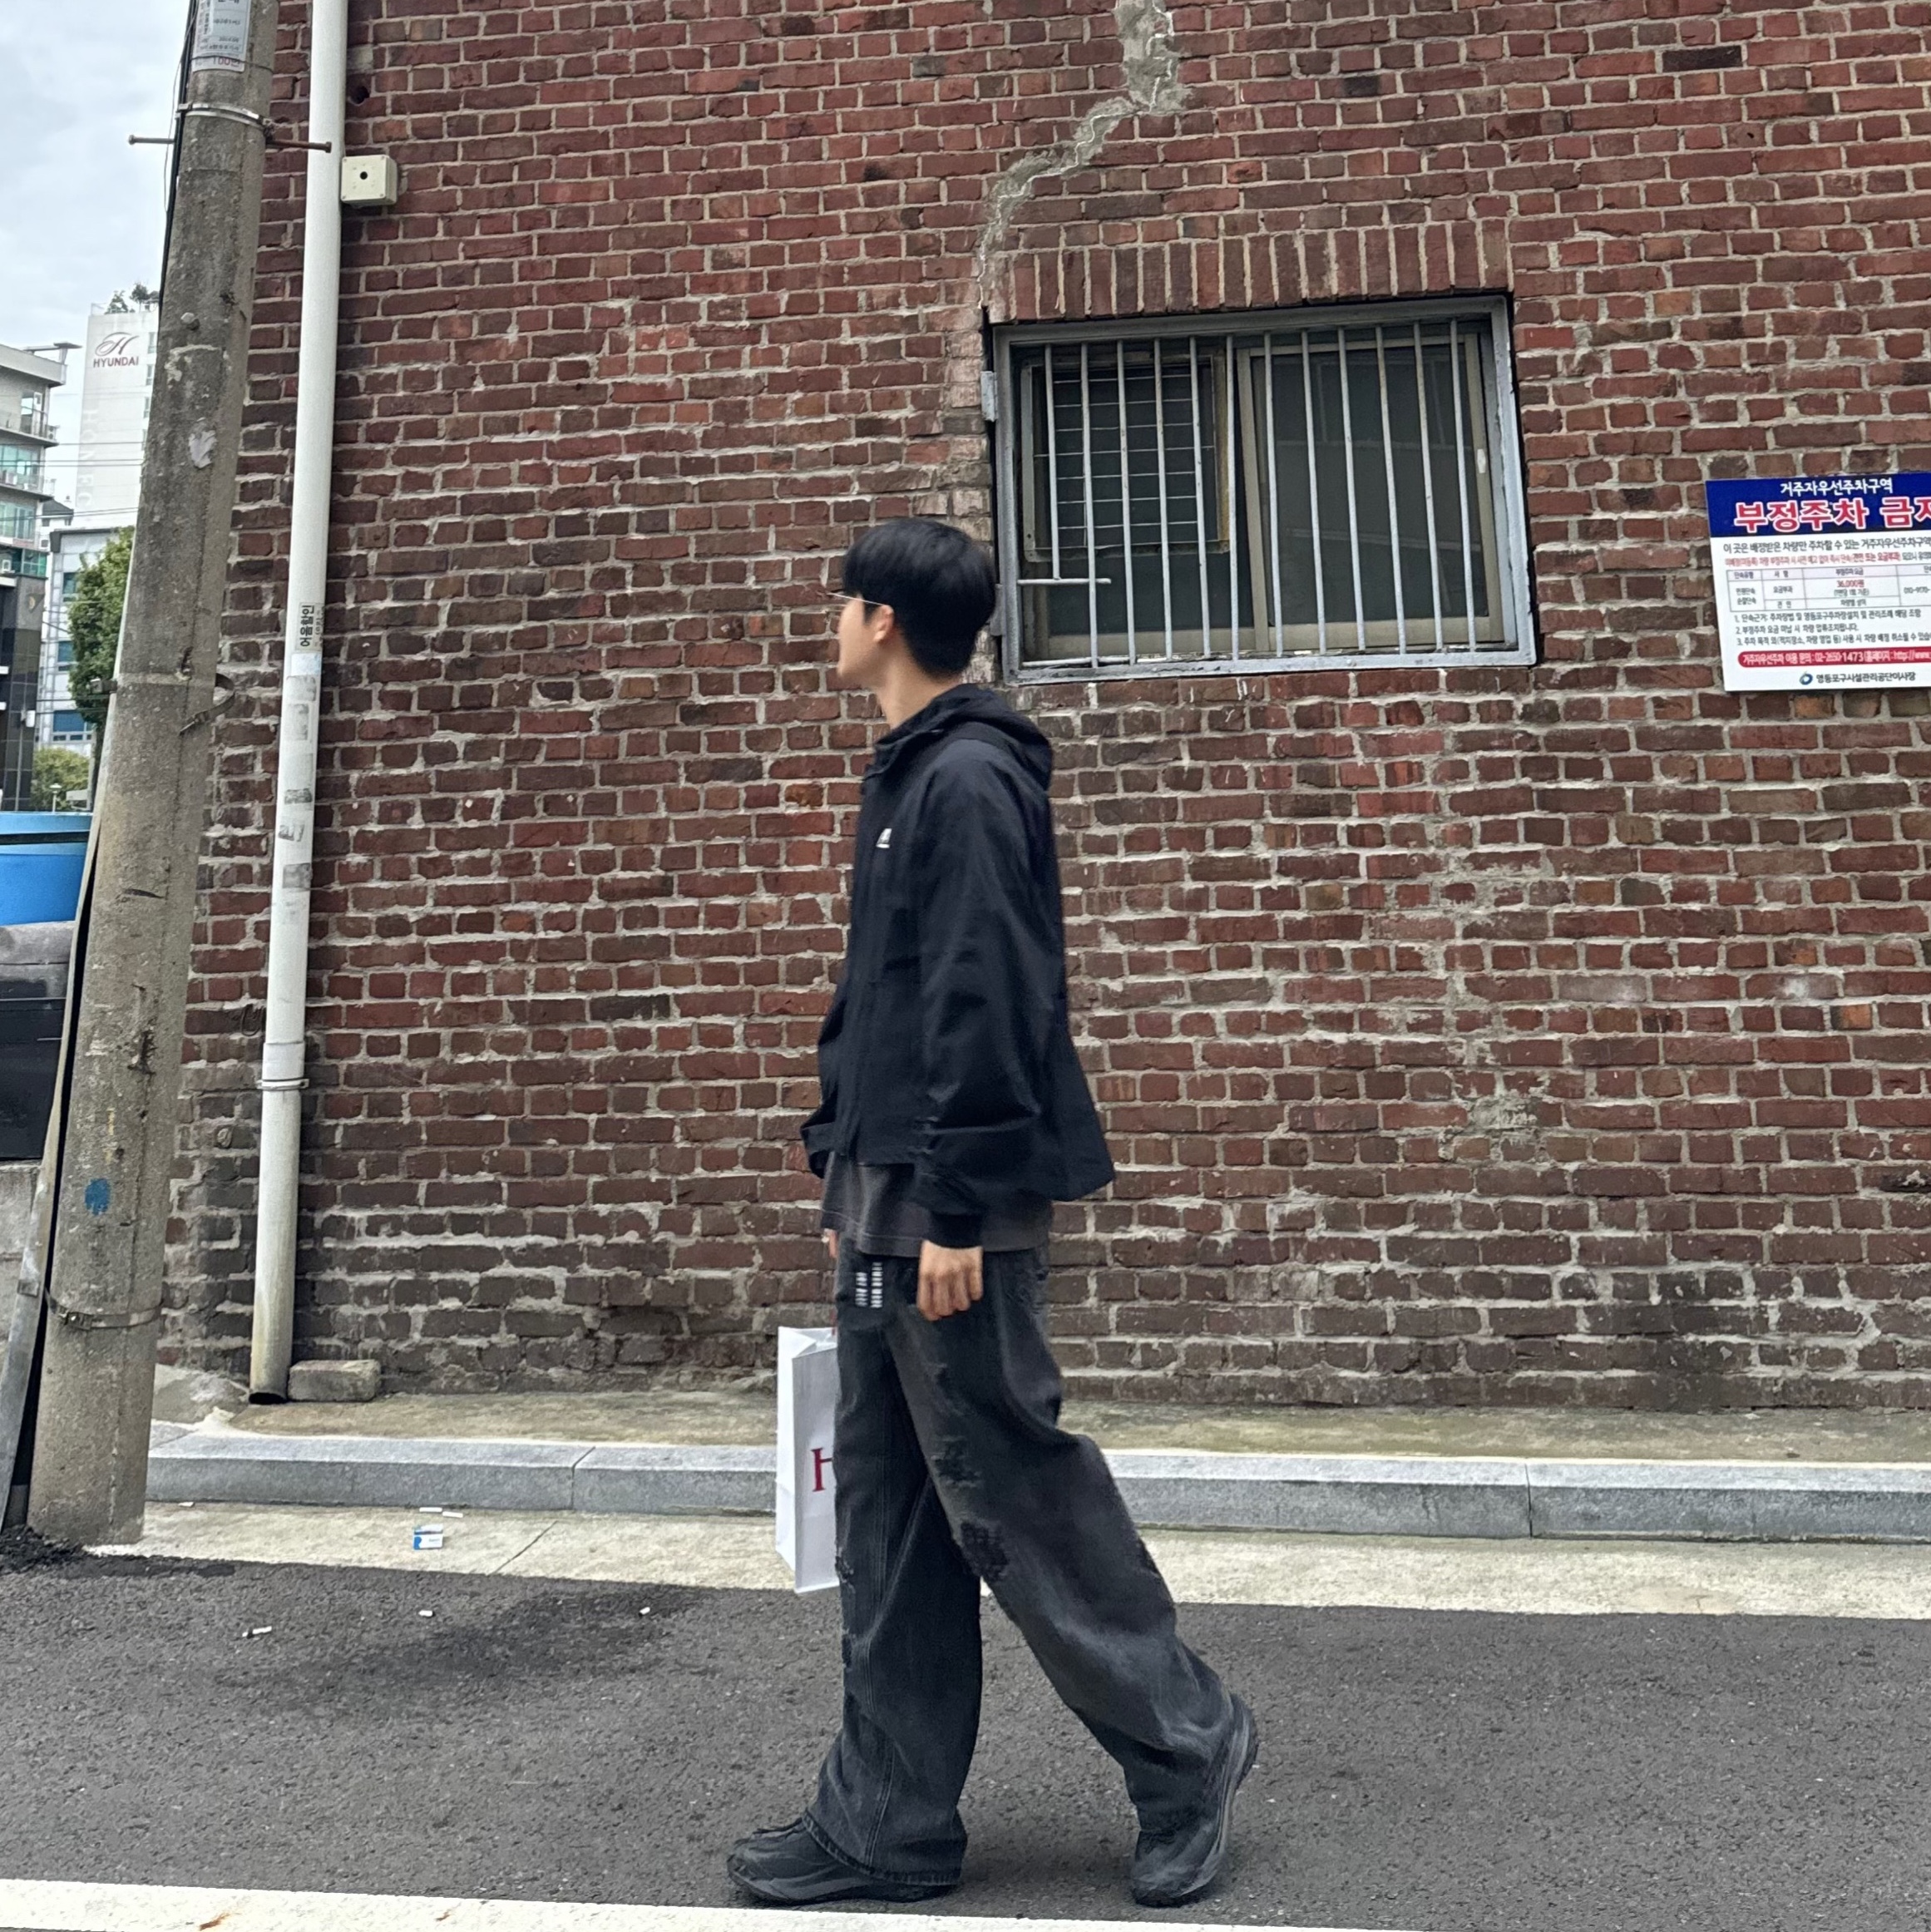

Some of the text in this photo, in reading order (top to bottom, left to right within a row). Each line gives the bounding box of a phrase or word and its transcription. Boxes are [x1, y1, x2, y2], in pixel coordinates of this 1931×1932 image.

[93, 356, 140, 368] HYUNDAI
[1780, 477, 1894, 497] 거주자우선주차구역
[1734, 497, 1869, 533] 부정주차
[1723, 543, 1732, 554] 이
[1733, 542, 1749, 554] 곳은
[1750, 541, 1781, 553] 배정받은
[1783, 541, 1807, 552] 차량만
[1808, 540, 1833, 551] 주차할
[1835, 540, 1843, 550] 수
[1843, 539, 1860, 550] 있는
[299, 605, 314, 647] 어음할인
[1742, 625, 1766, 635] 부정주차
[1767, 624, 1780, 635] 요금
